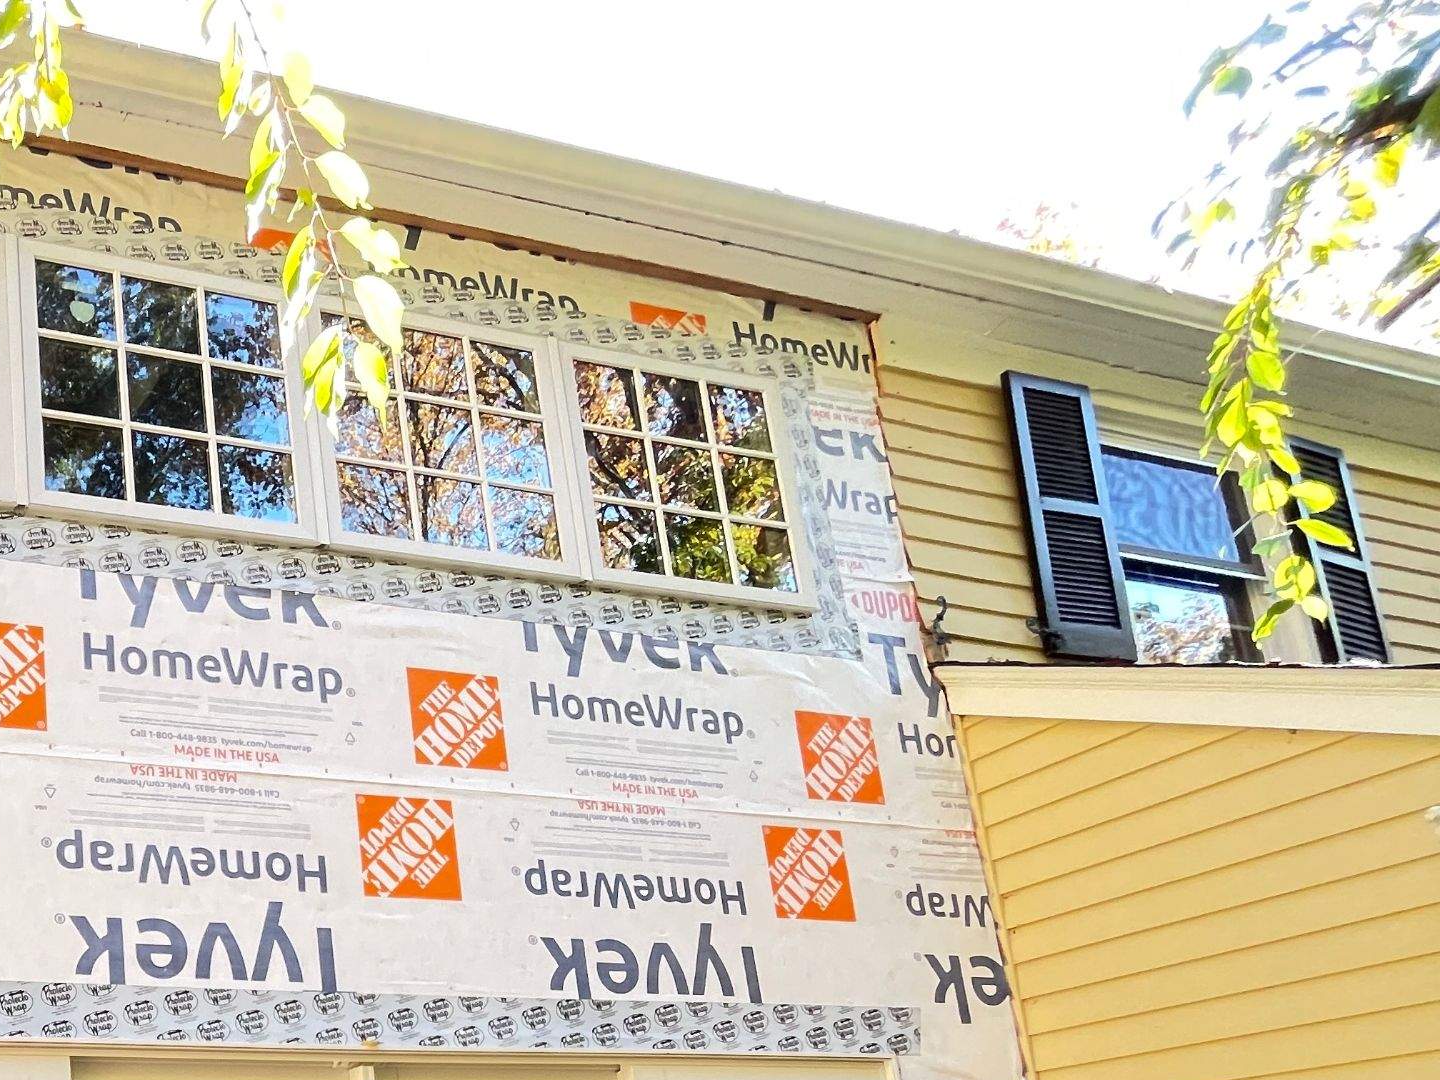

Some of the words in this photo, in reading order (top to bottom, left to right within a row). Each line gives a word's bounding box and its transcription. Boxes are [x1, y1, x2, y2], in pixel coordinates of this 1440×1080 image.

[82, 632, 344, 703] HomeWrap
[419, 680, 457, 717] THE
[529, 681, 744, 744] HomeWrap
[415, 674, 500, 766] HOME
[807, 721, 839, 757] THE
[130, 729, 147, 738] Call
[148, 731, 217, 744] 1-800-448-9835
[221, 737, 312, 753] tyvek.com/homewrap
[174, 745, 211, 758] MADE
[214, 749, 227, 759] IN
[229, 750, 253, 761] THE
[256, 752, 280, 764] USA
[451, 711, 504, 768] DEPOT
[805, 716, 874, 800] HOME
[130, 764, 155, 776] USA
[159, 767, 182, 778] THE
[185, 769, 199, 780] IN
[201, 770, 238, 783] MADE
[837, 749, 880, 803] DEPOT
[578, 800, 599, 811] USA
[601, 802, 621, 813] THE
[612, 782, 643, 794] MADE
[645, 786, 656, 795] IN
[657, 786, 677, 797] THE
[679, 789, 699, 799] USA
[623, 804, 634, 814] IN
[360, 796, 416, 859] DEPOT
[636, 805, 666, 816] MADE
[56, 829, 328, 894] HomeWrap
[361, 798, 454, 898] HOME
[769, 827, 813, 883] DEPOT
[410, 848, 450, 888] THE
[775, 829, 845, 920] HOME
[524, 859, 747, 916] HomeWrap
